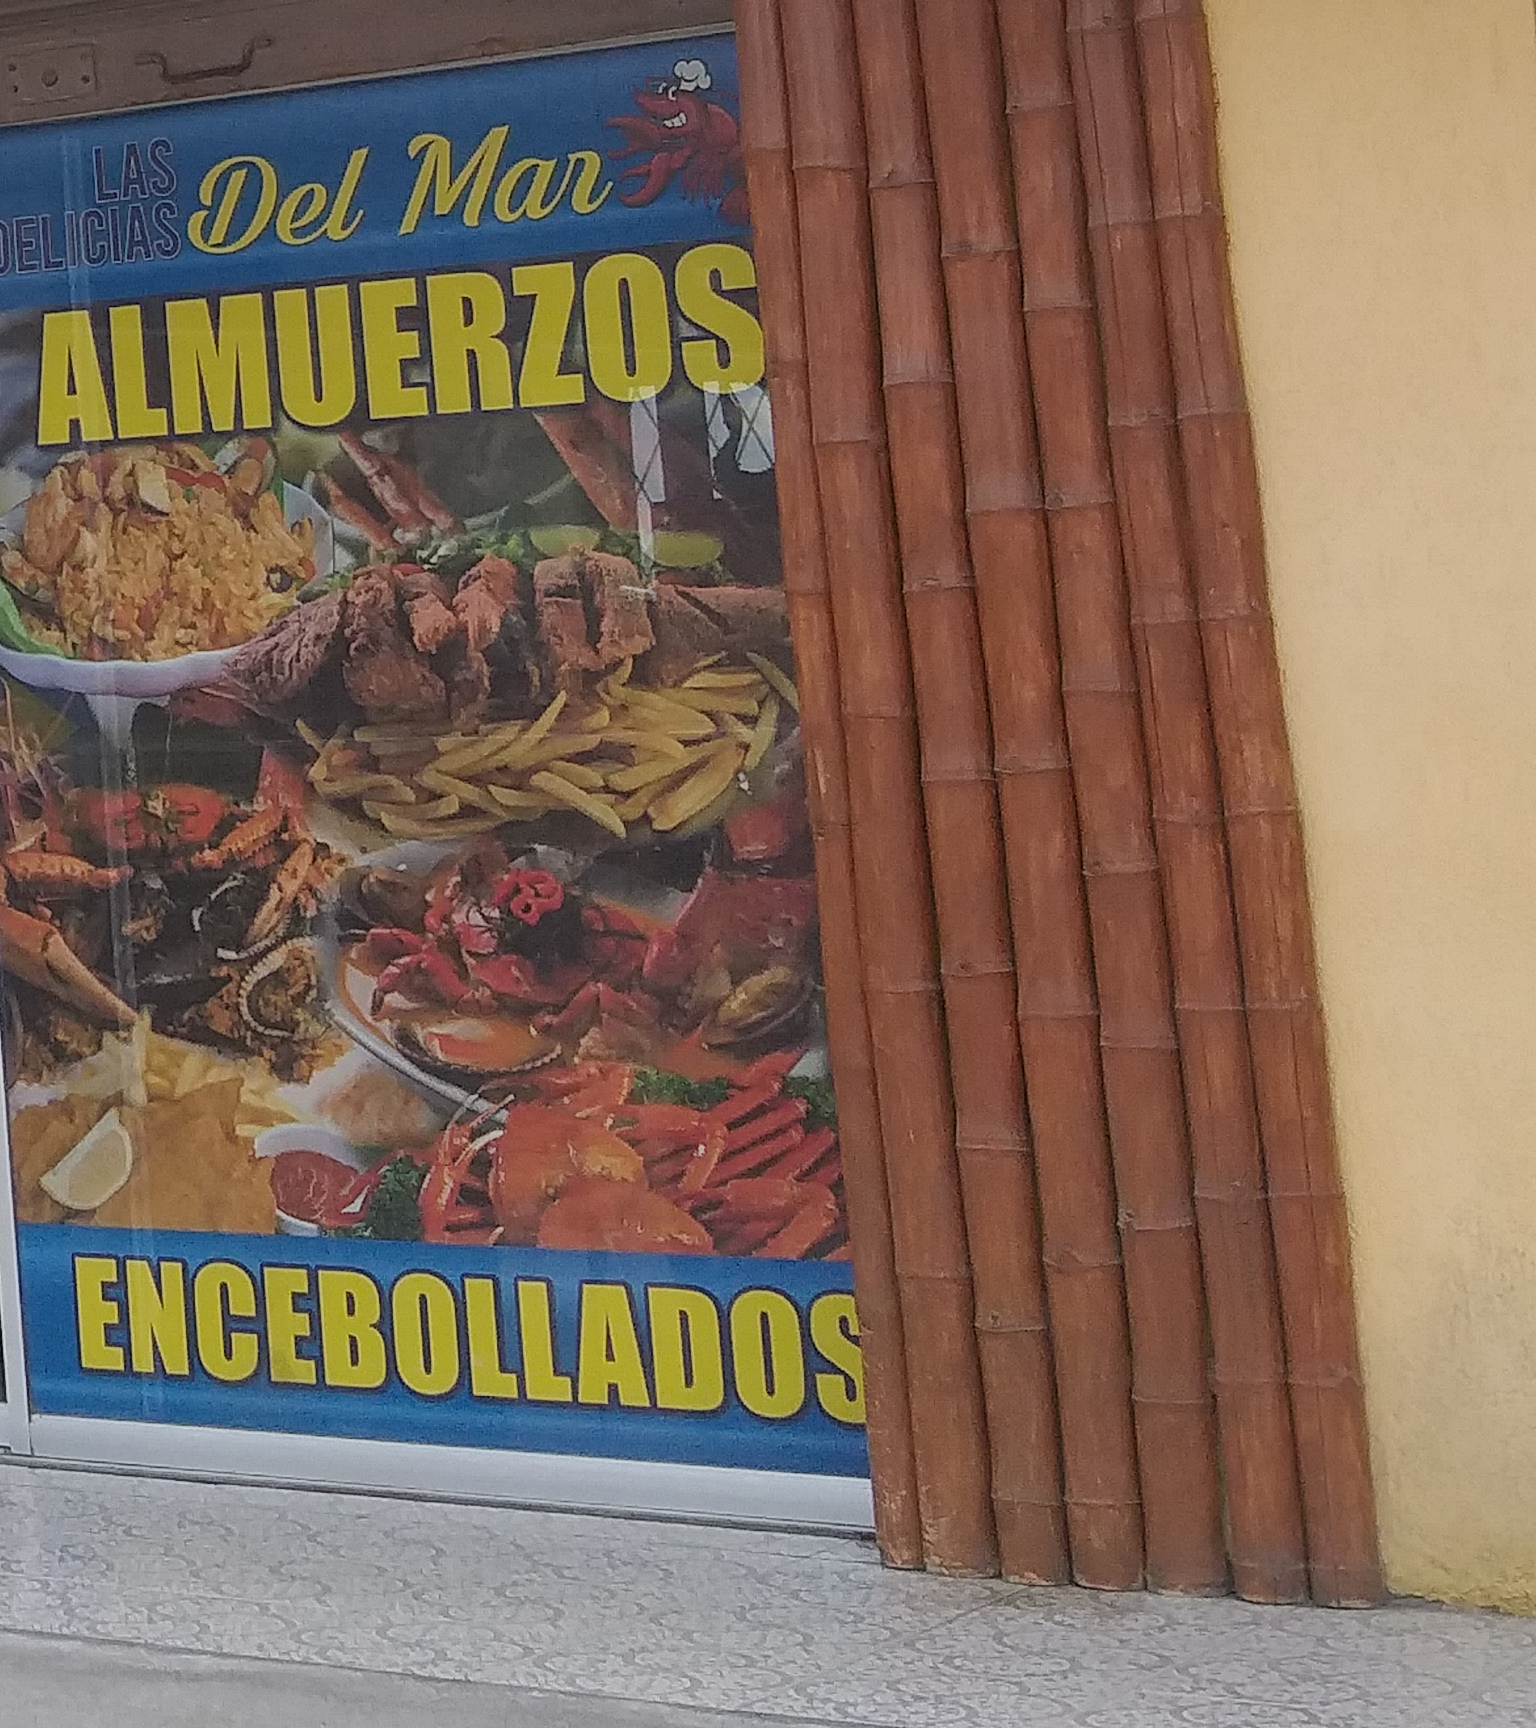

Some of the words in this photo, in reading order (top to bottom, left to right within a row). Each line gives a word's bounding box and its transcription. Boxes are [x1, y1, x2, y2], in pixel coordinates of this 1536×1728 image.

[93, 137, 178, 203] LAS
[187, 145, 370, 255] Del
[399, 124, 614, 237] Mar
[37, 242, 766, 448] ALMUERZOS
[73, 1252, 868, 1426] ENCEBOLLADOS
